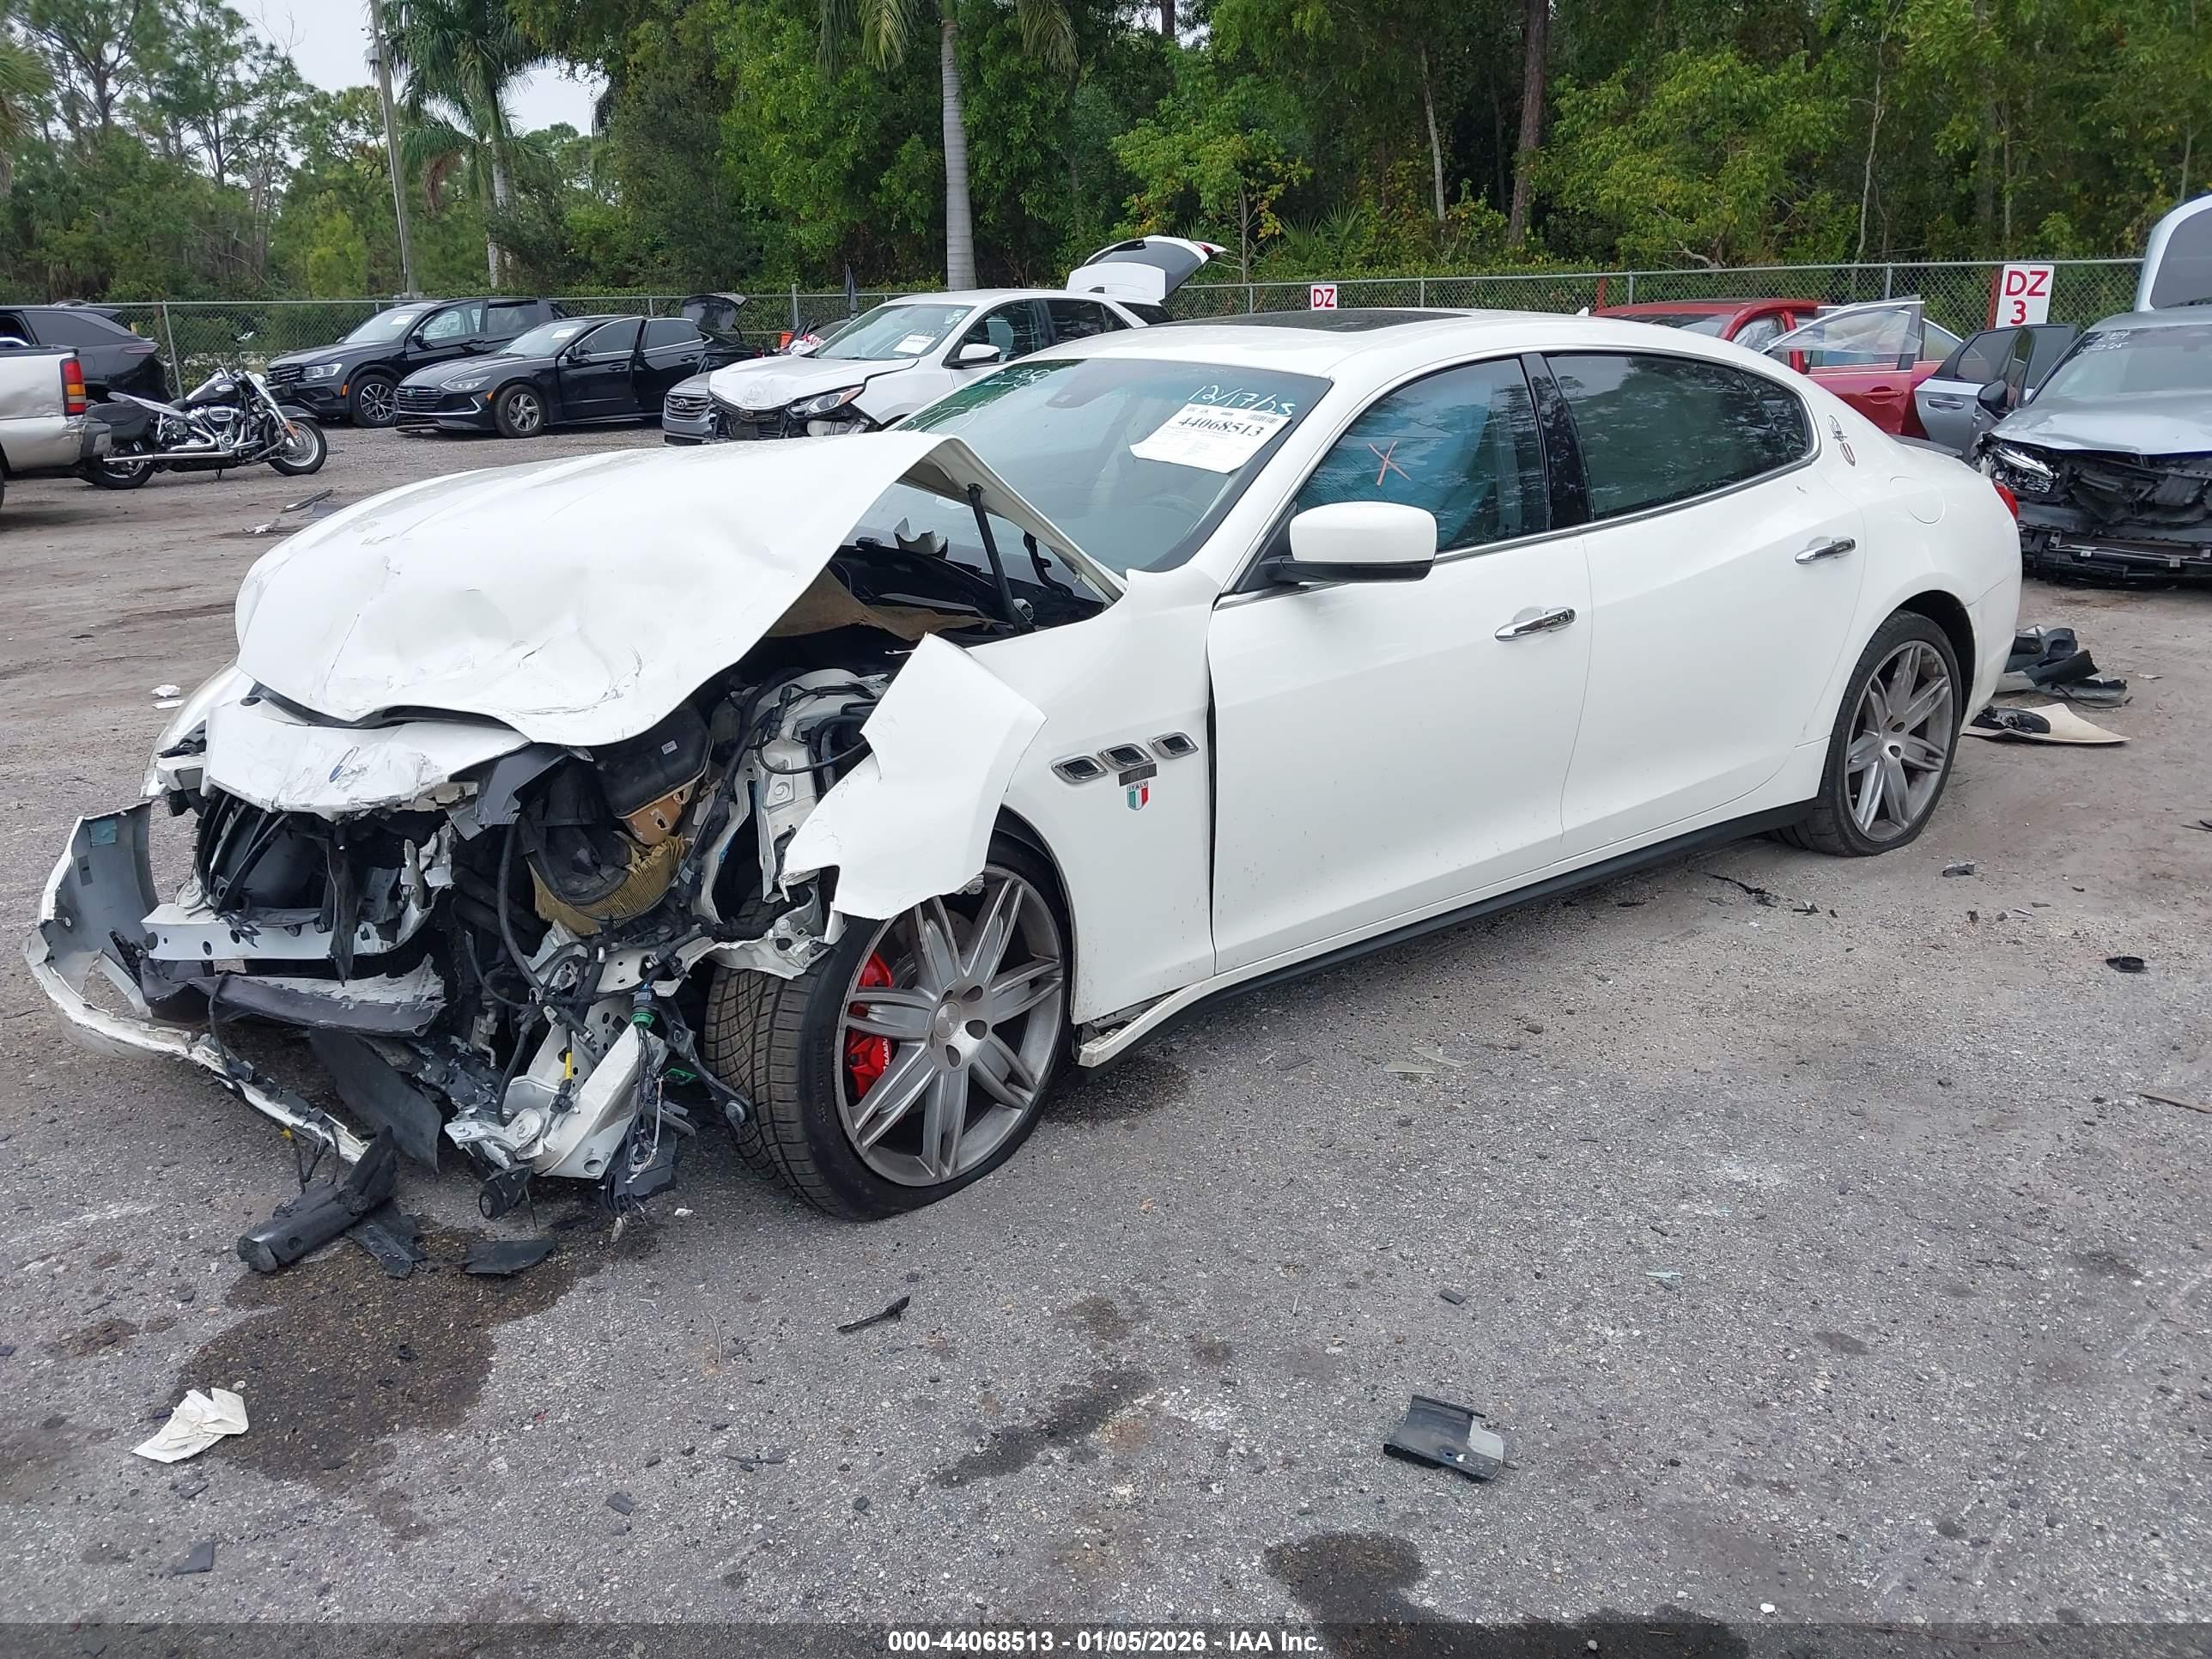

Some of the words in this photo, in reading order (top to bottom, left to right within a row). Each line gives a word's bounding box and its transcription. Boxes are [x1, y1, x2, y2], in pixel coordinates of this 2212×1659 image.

[2005, 270, 2048, 296] DZ
[1313, 289, 1334, 307] DZ
[2010, 301, 2027, 325] 3
[1178, 417, 1264, 437] 44068513
[1129, 781, 1148, 791] ITALY
